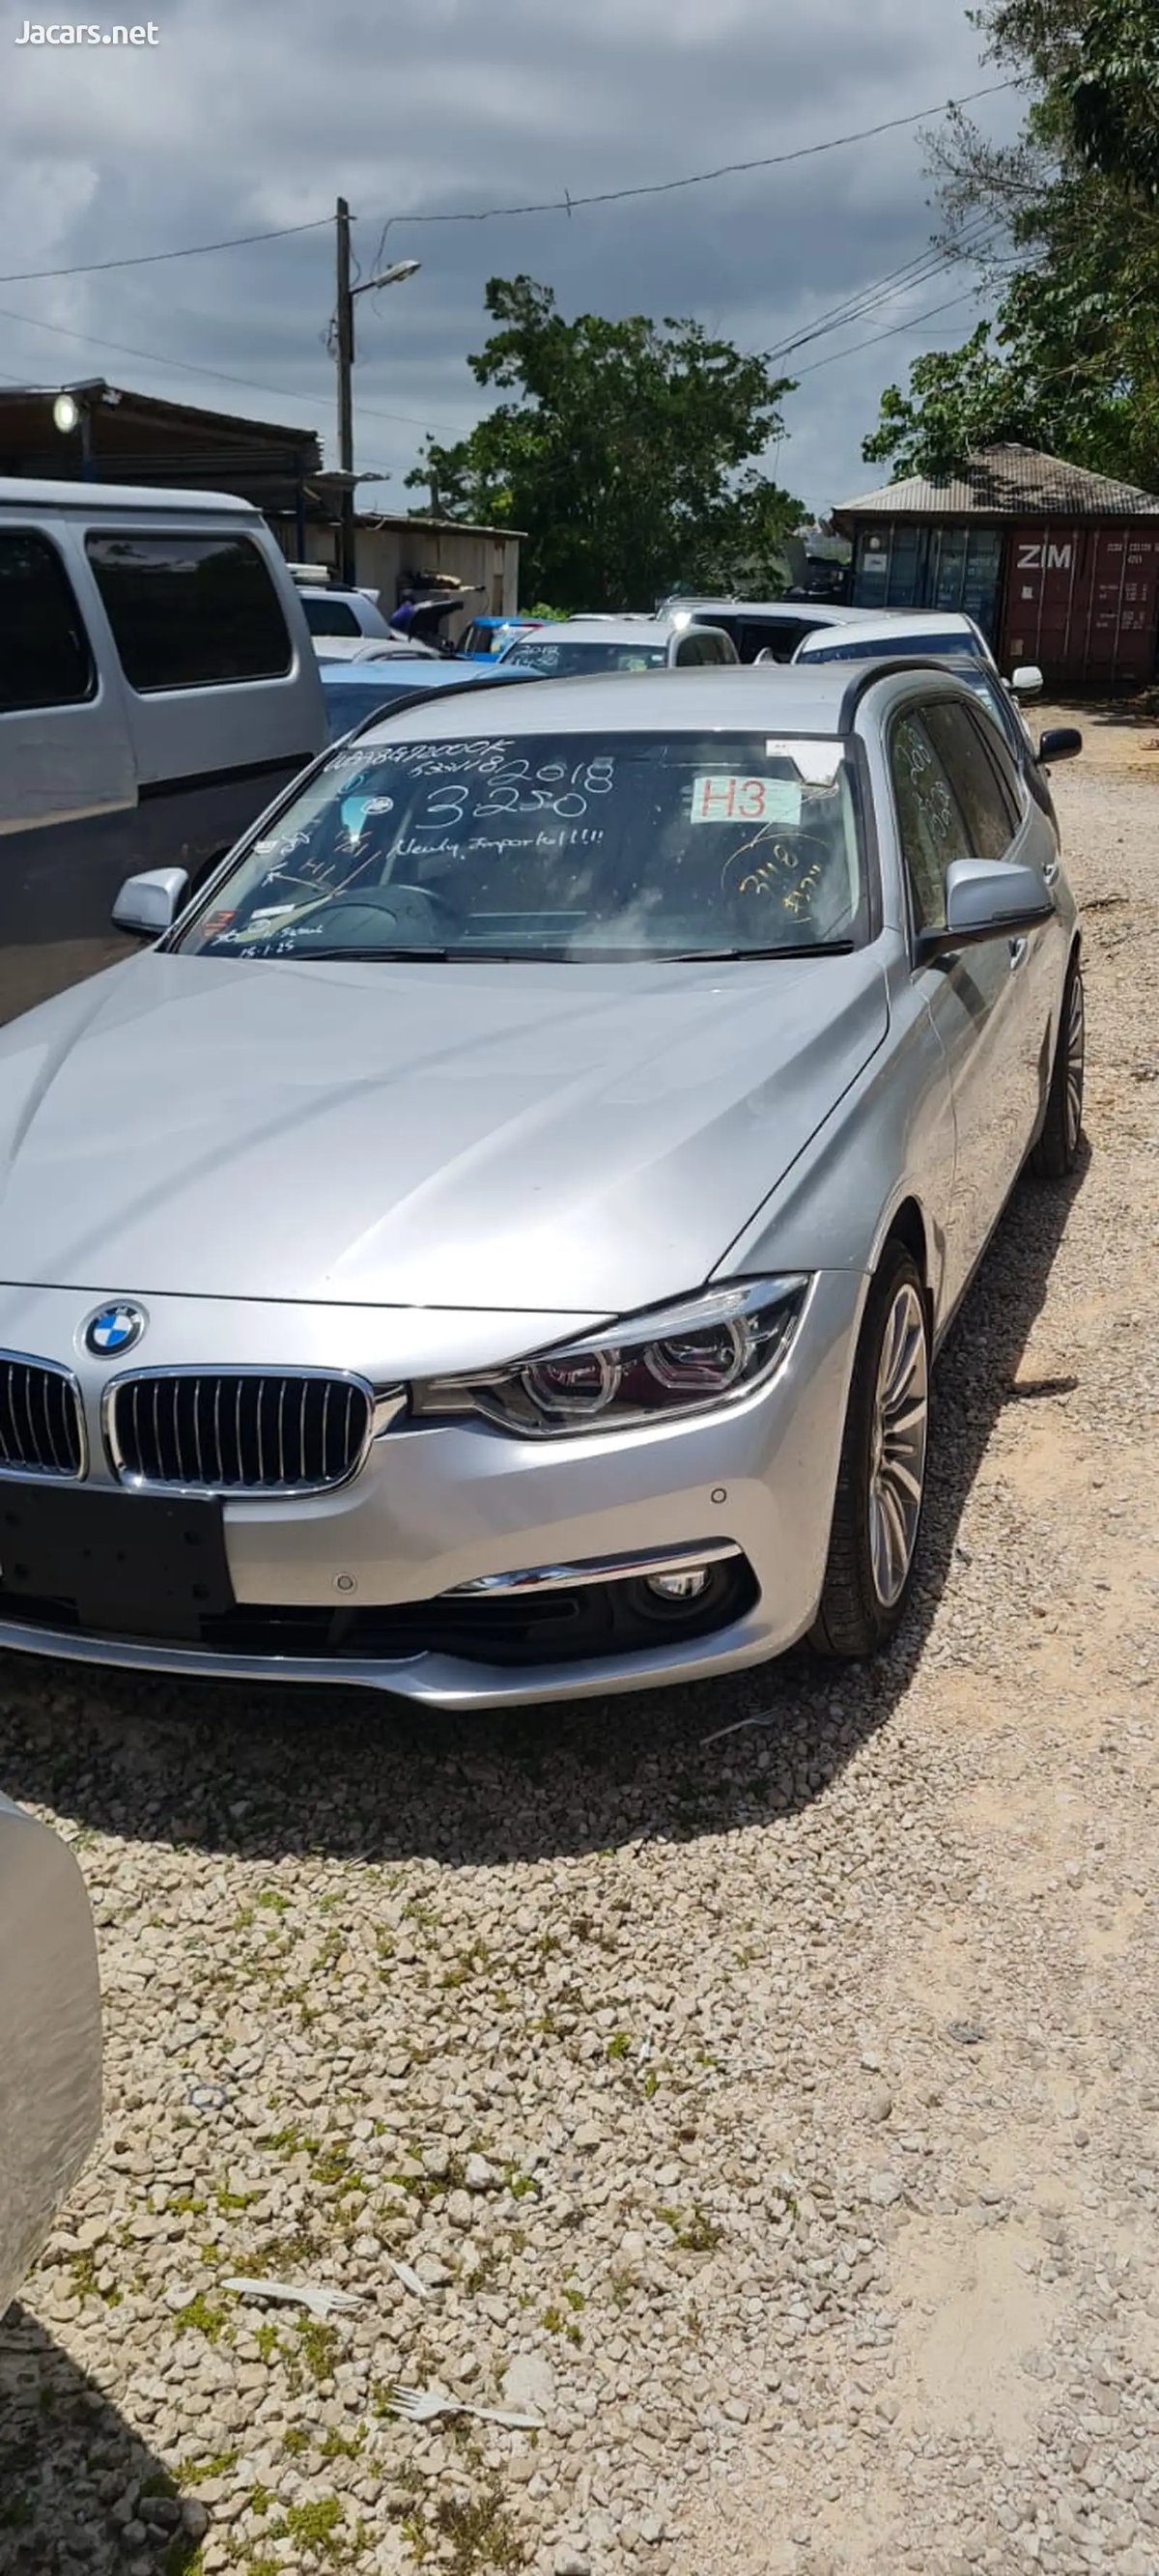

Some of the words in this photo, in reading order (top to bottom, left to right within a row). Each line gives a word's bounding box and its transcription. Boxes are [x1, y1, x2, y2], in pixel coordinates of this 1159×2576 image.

[1017, 544, 1072, 569] ZIM
[415, 784, 587, 830] 3250
[699, 779, 768, 819] H3
